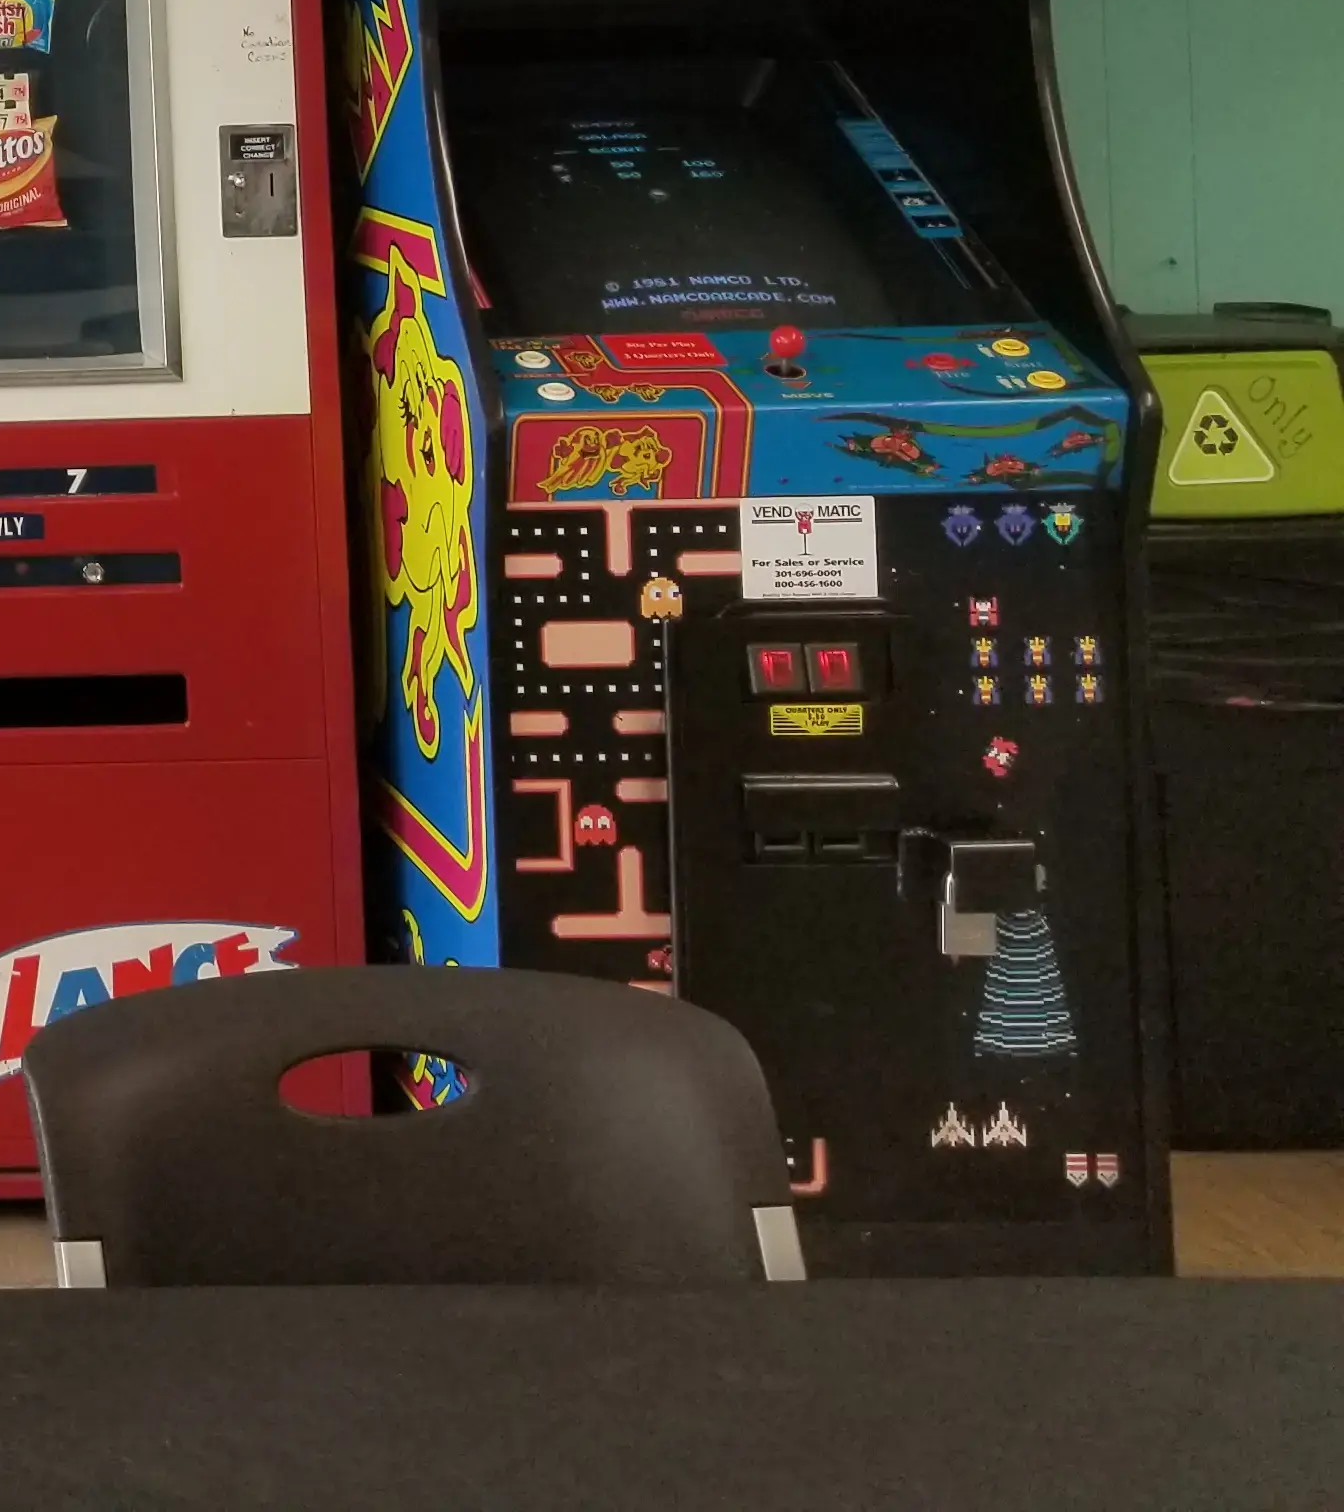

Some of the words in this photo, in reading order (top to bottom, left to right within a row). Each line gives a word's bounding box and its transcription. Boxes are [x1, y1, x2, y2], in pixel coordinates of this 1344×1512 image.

[0, 117, 7, 130] 7
[632, 277, 680, 289] 1981
[688, 275, 753, 286] NAMCO
[764, 276, 809, 287] LTD.
[601, 291, 836, 309] WWW.NAMCOARCADE.COM
[1248, 375, 1313, 459] Only
[66, 469, 87, 494] 7
[753, 506, 792, 518] VEND
[818, 505, 861, 517] MATIC
[752, 559, 771, 567] For
[774, 559, 804, 567] Sales
[824, 558, 864, 566] Service
